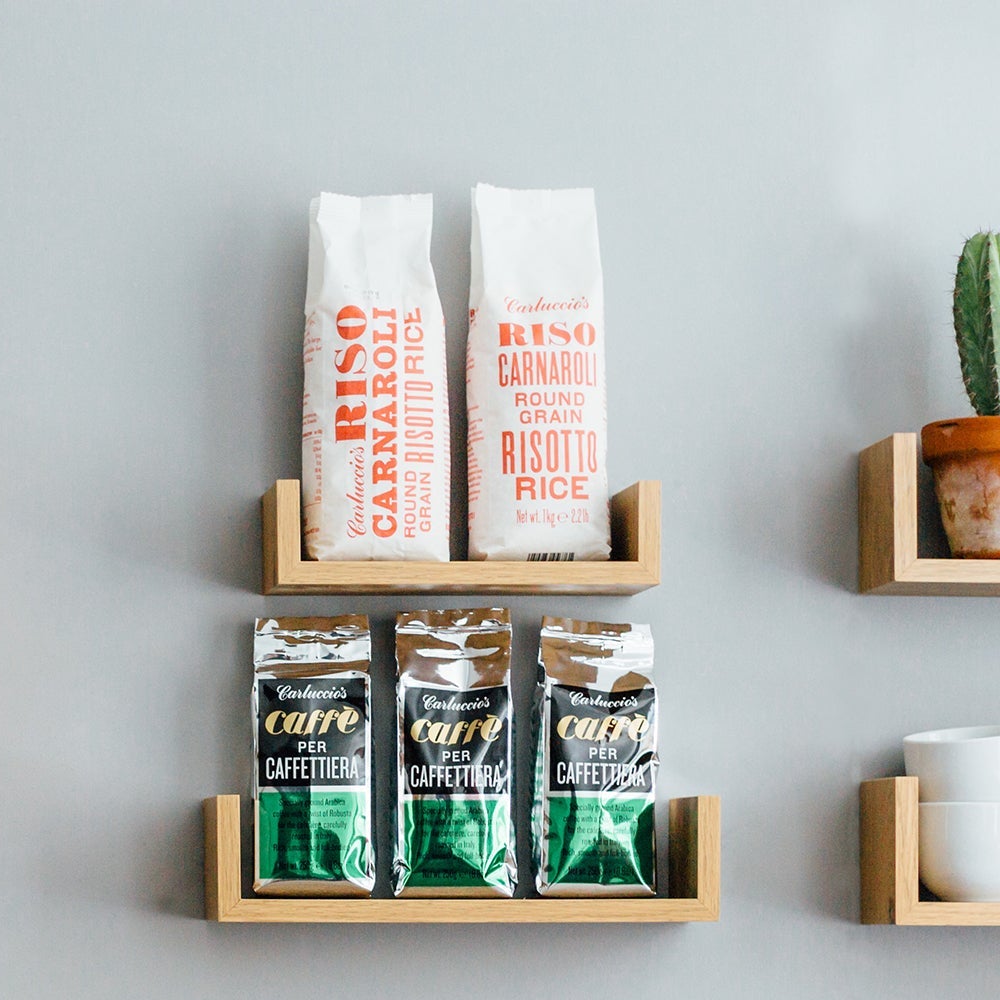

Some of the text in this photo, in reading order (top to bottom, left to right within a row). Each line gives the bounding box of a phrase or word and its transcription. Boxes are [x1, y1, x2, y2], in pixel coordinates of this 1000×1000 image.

[504, 296, 590, 314] Carluccio's
[498, 322, 596, 348] RISO
[498, 351, 597, 388] CARNAROLI
[404, 307, 434, 464] RISOTTO RICE
[515, 392, 585, 407] ROUND
[334, 304, 368, 538] Carluccio's RISO
[372, 307, 397, 538] CARNAROLI
[519, 410, 583, 424] GRAIN
[502, 430, 598, 474] RISOTTO
[516, 476, 589, 500] RICE
[404, 470, 417, 538] ROUND
[420, 472, 432, 532] GRAIN
[276, 684, 347, 701] Carluccio's
[422, 694, 490, 711] Carluccio's
[569, 692, 638, 708] Carluccio's
[265, 706, 360, 736] caffè
[410, 714, 502, 746] caffè
[557, 713, 650, 742] caffè
[298, 741, 327, 753] PER
[442, 750, 470, 762] PER
[589, 748, 618, 760] PER
[266, 757, 359, 780] CAFFETTIERA
[410, 764, 501, 788] CAFFETTIERA
[557, 762, 646, 787] CAFFETTIERA
